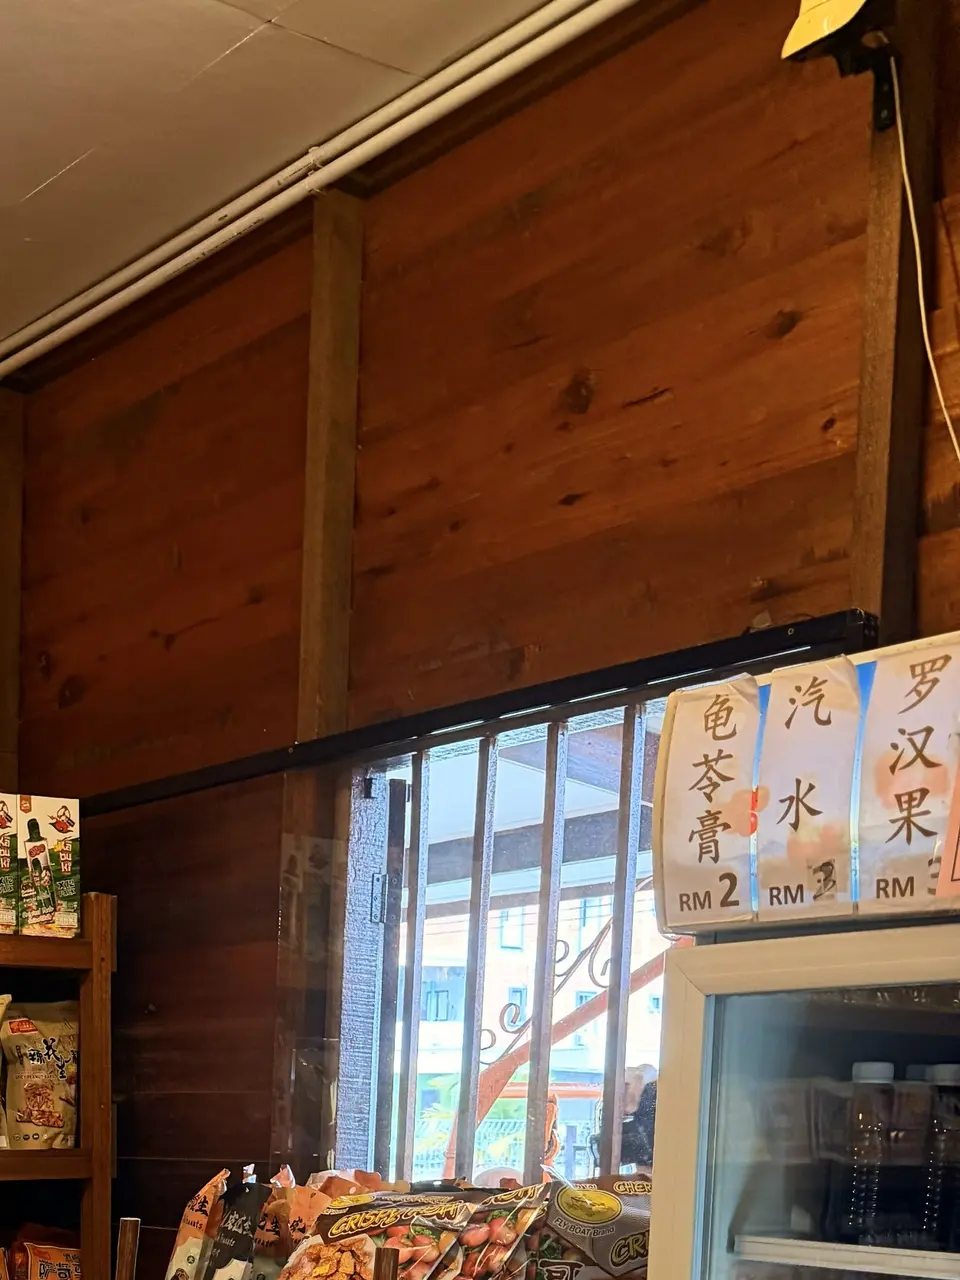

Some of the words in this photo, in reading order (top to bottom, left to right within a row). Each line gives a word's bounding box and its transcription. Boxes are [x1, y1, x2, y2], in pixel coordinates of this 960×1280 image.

[776, 676, 832, 832] 汽水
[885, 654, 952, 845] 罗汉果
[688, 693, 737, 864] 龟苓膏
[679, 891, 712, 911] RM
[718, 872, 740, 908] 2
[769, 884, 804, 906] RM
[876, 876, 915, 899] RM
[329, 1209, 400, 1238] CRISPY
[554, 1217, 569, 1230] FLY
[569, 1224, 591, 1236] BOAT
[592, 1226, 615, 1237] Brand
